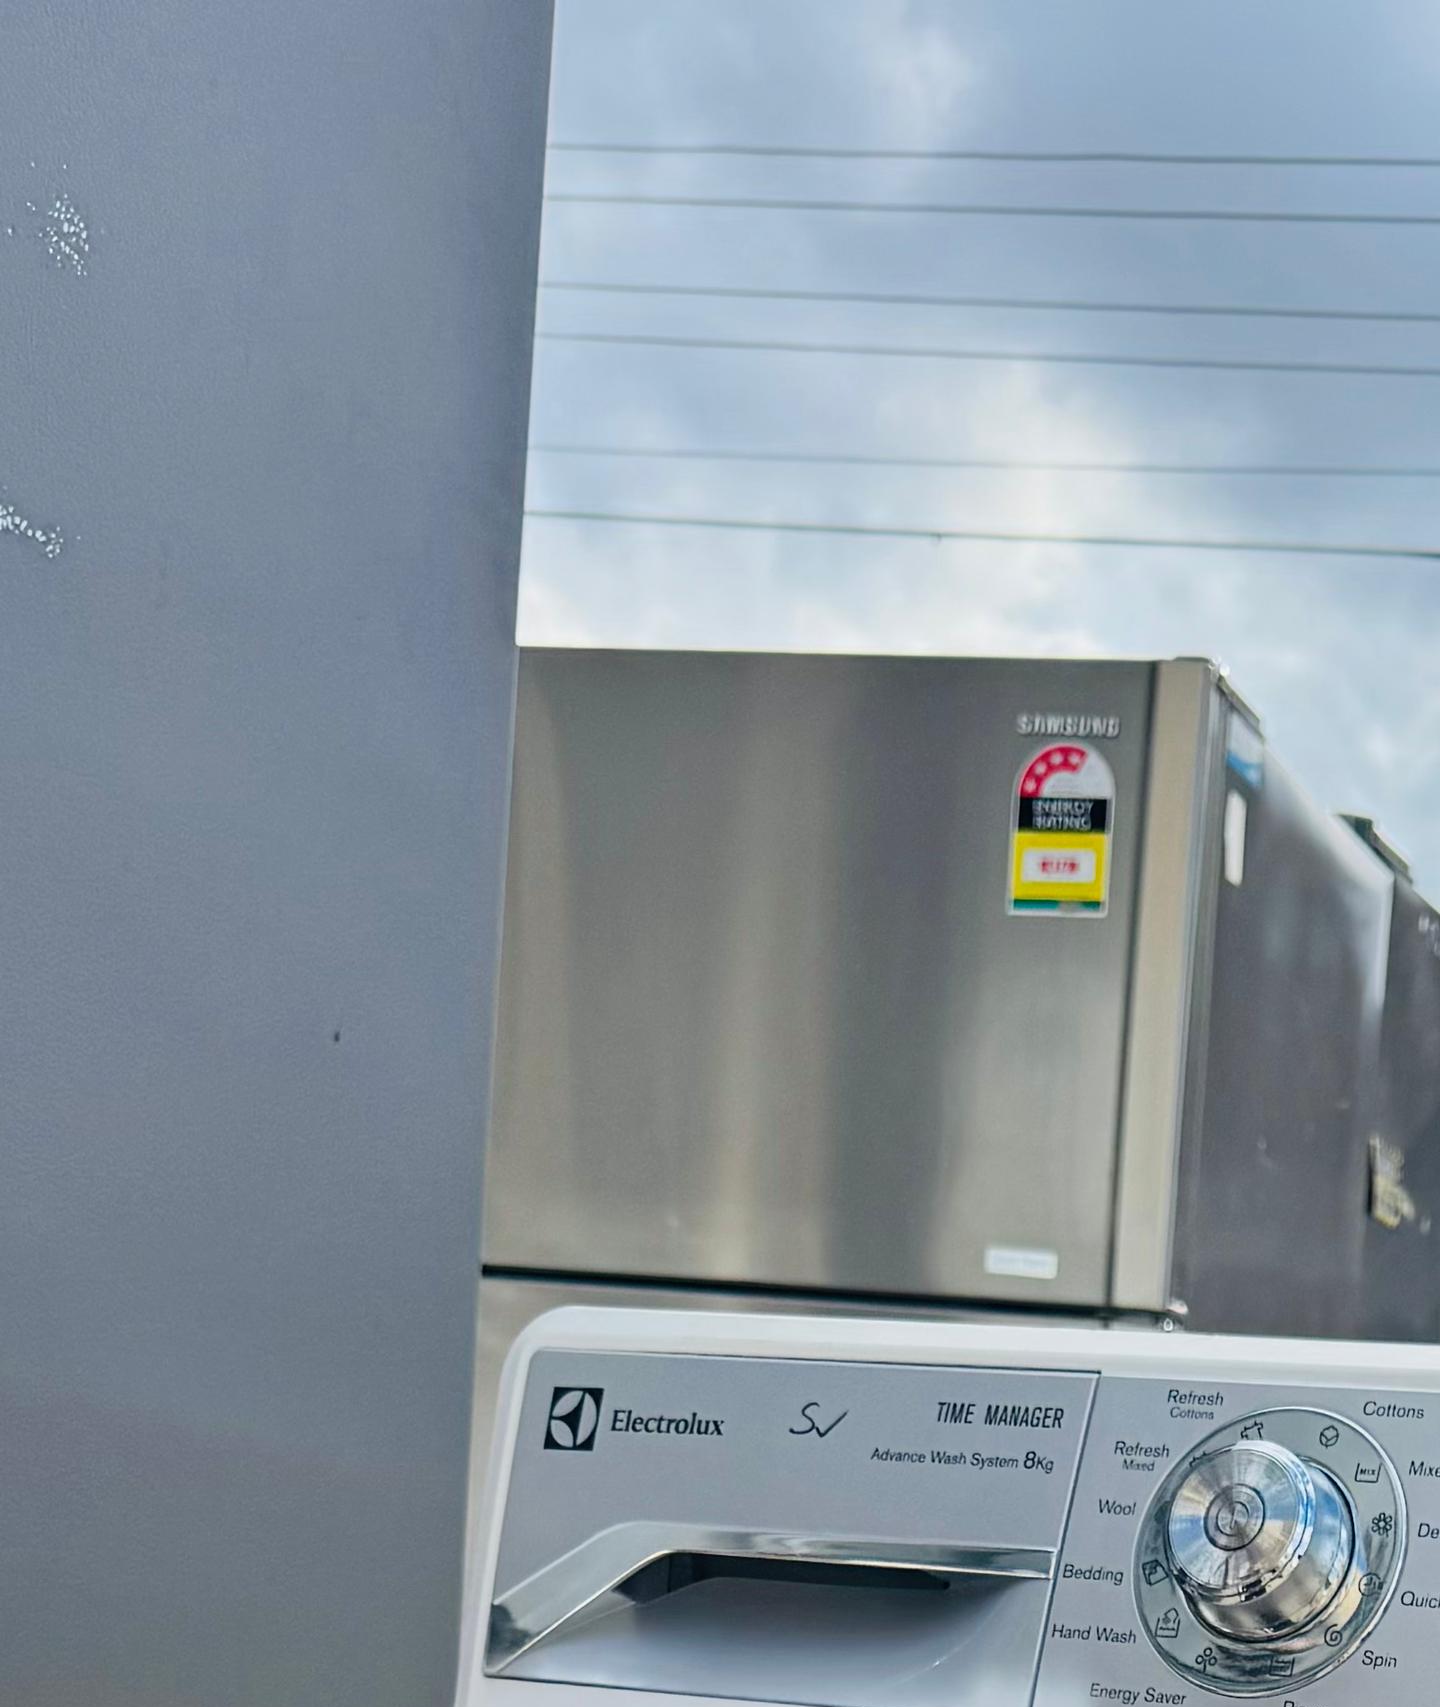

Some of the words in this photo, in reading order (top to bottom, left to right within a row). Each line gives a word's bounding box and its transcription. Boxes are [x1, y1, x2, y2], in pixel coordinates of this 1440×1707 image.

[1017, 713, 1120, 739] SAMSUNG
[1168, 1389, 1224, 1407] Refresh
[936, 1401, 976, 1427] TIME
[984, 1404, 1065, 1430] MANAGER
[1363, 1401, 1425, 1420] Cottons
[610, 1408, 725, 1439] Electrolux
[1114, 1440, 1170, 1459] Refresh
[870, 1447, 926, 1465] Advance
[930, 1450, 967, 1466] Wash
[970, 1452, 1019, 1470] System
[1022, 1449, 1054, 1474] 8Kg
[1098, 1499, 1136, 1517] Wool
[1062, 1564, 1124, 1586] Bedding
[1052, 1623, 1091, 1641] Hand
[1096, 1626, 1136, 1644] Wash
[1361, 1650, 1397, 1670] Spin
[1090, 1683, 1141, 1705] Energy
[1144, 1687, 1186, 1706] Saver
